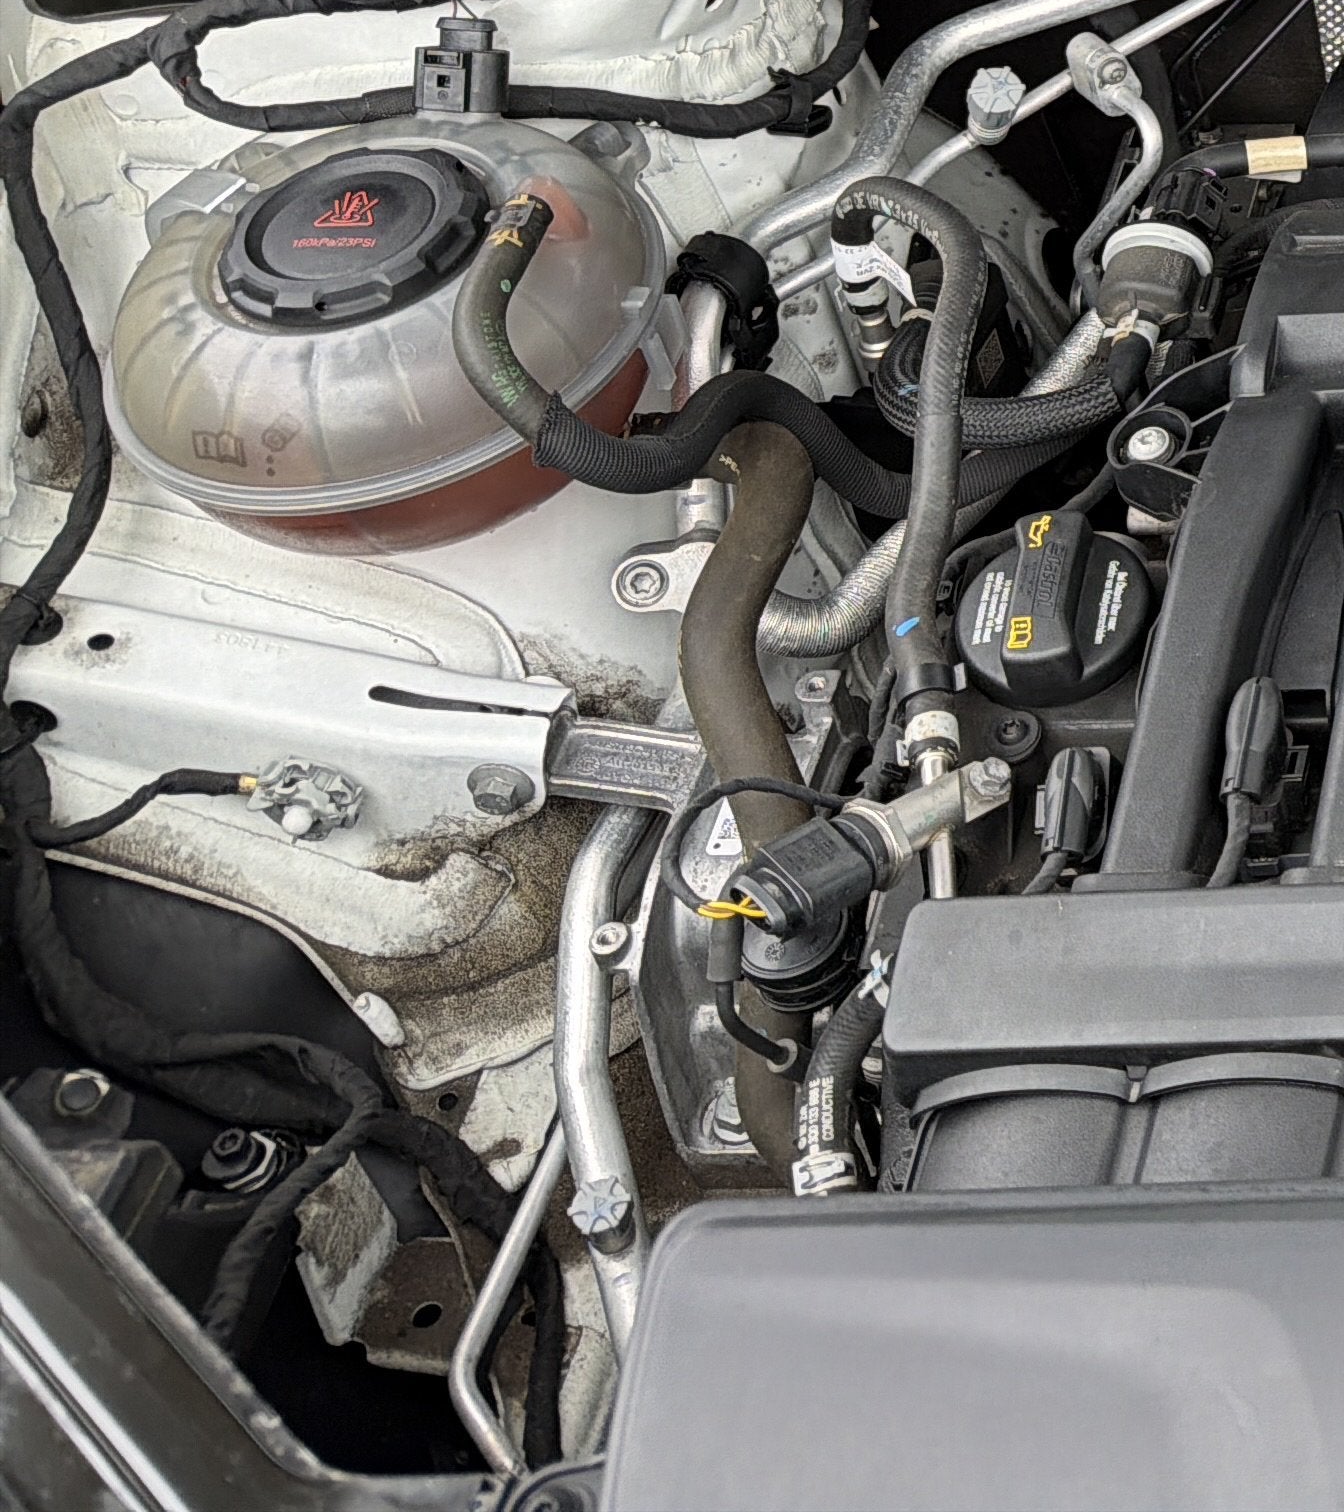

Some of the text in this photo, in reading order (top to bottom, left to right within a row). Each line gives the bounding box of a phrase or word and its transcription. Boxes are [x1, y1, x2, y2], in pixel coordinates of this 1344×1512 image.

[293, 236, 377, 249] 160kPa/23PSI
[1036, 555, 1063, 608] Castrol
[821, 1075, 835, 1141] CONDUCTIVE
